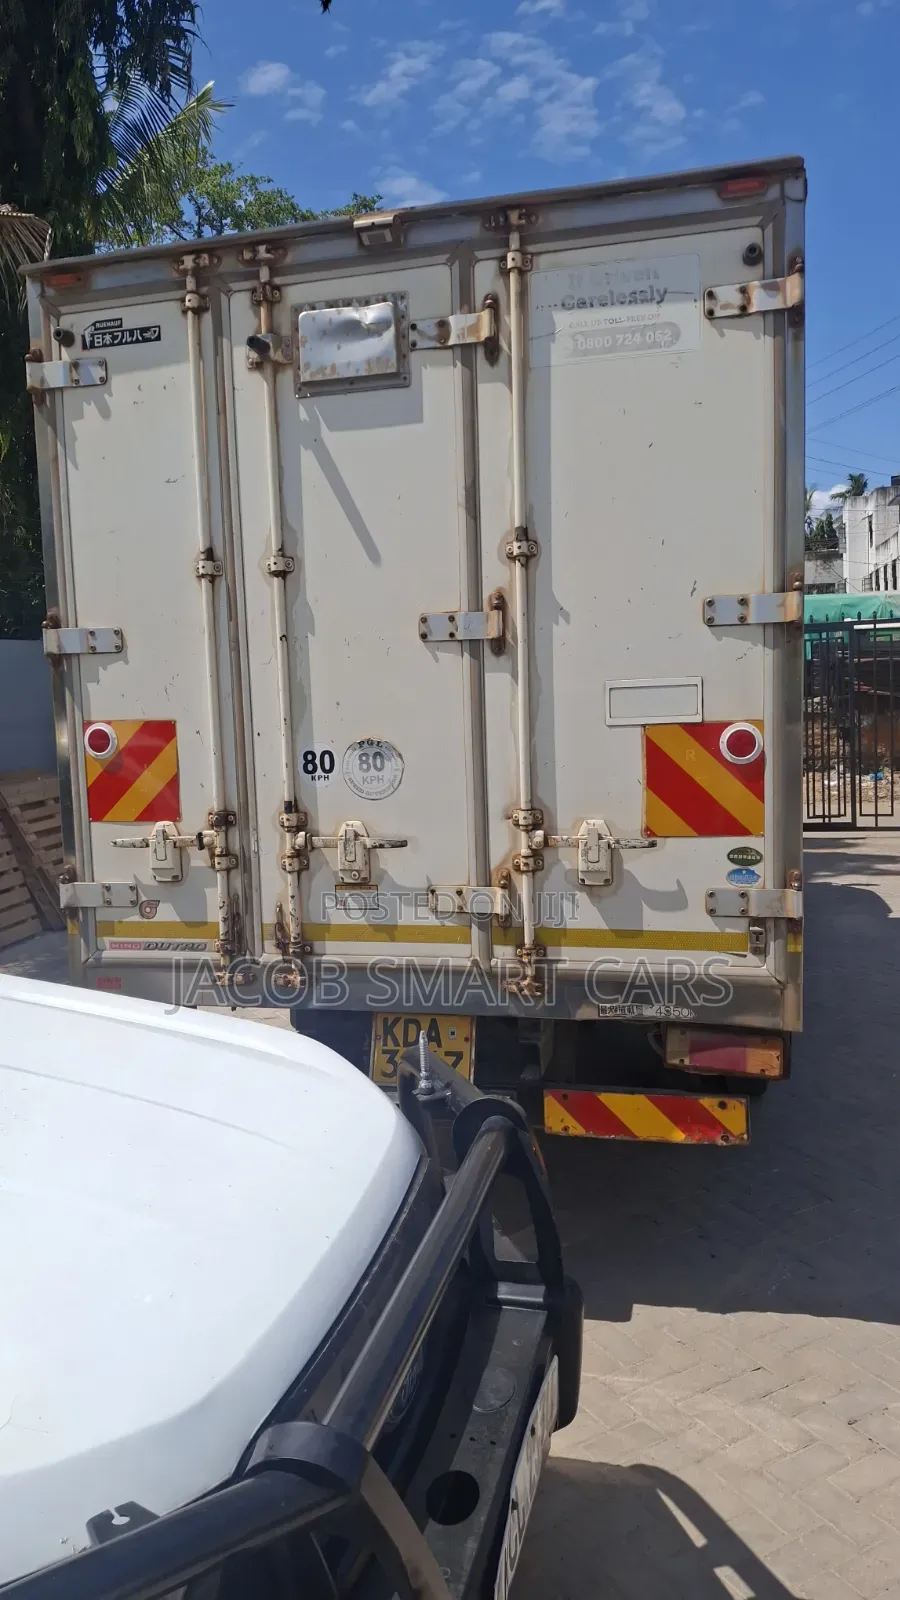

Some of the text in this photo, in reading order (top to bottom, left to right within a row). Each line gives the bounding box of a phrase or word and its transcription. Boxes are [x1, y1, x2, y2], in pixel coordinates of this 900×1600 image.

[577, 335, 612, 350] 0800
[615, 332, 641, 346] 724
[302, 750, 335, 775] 80
[358, 751, 385, 773] 80
[311, 774, 330, 782] KPH
[362, 774, 385, 785] KPH
[110, 942, 208, 951] HINO DUTRO
[382, 1016, 442, 1048] KDA
